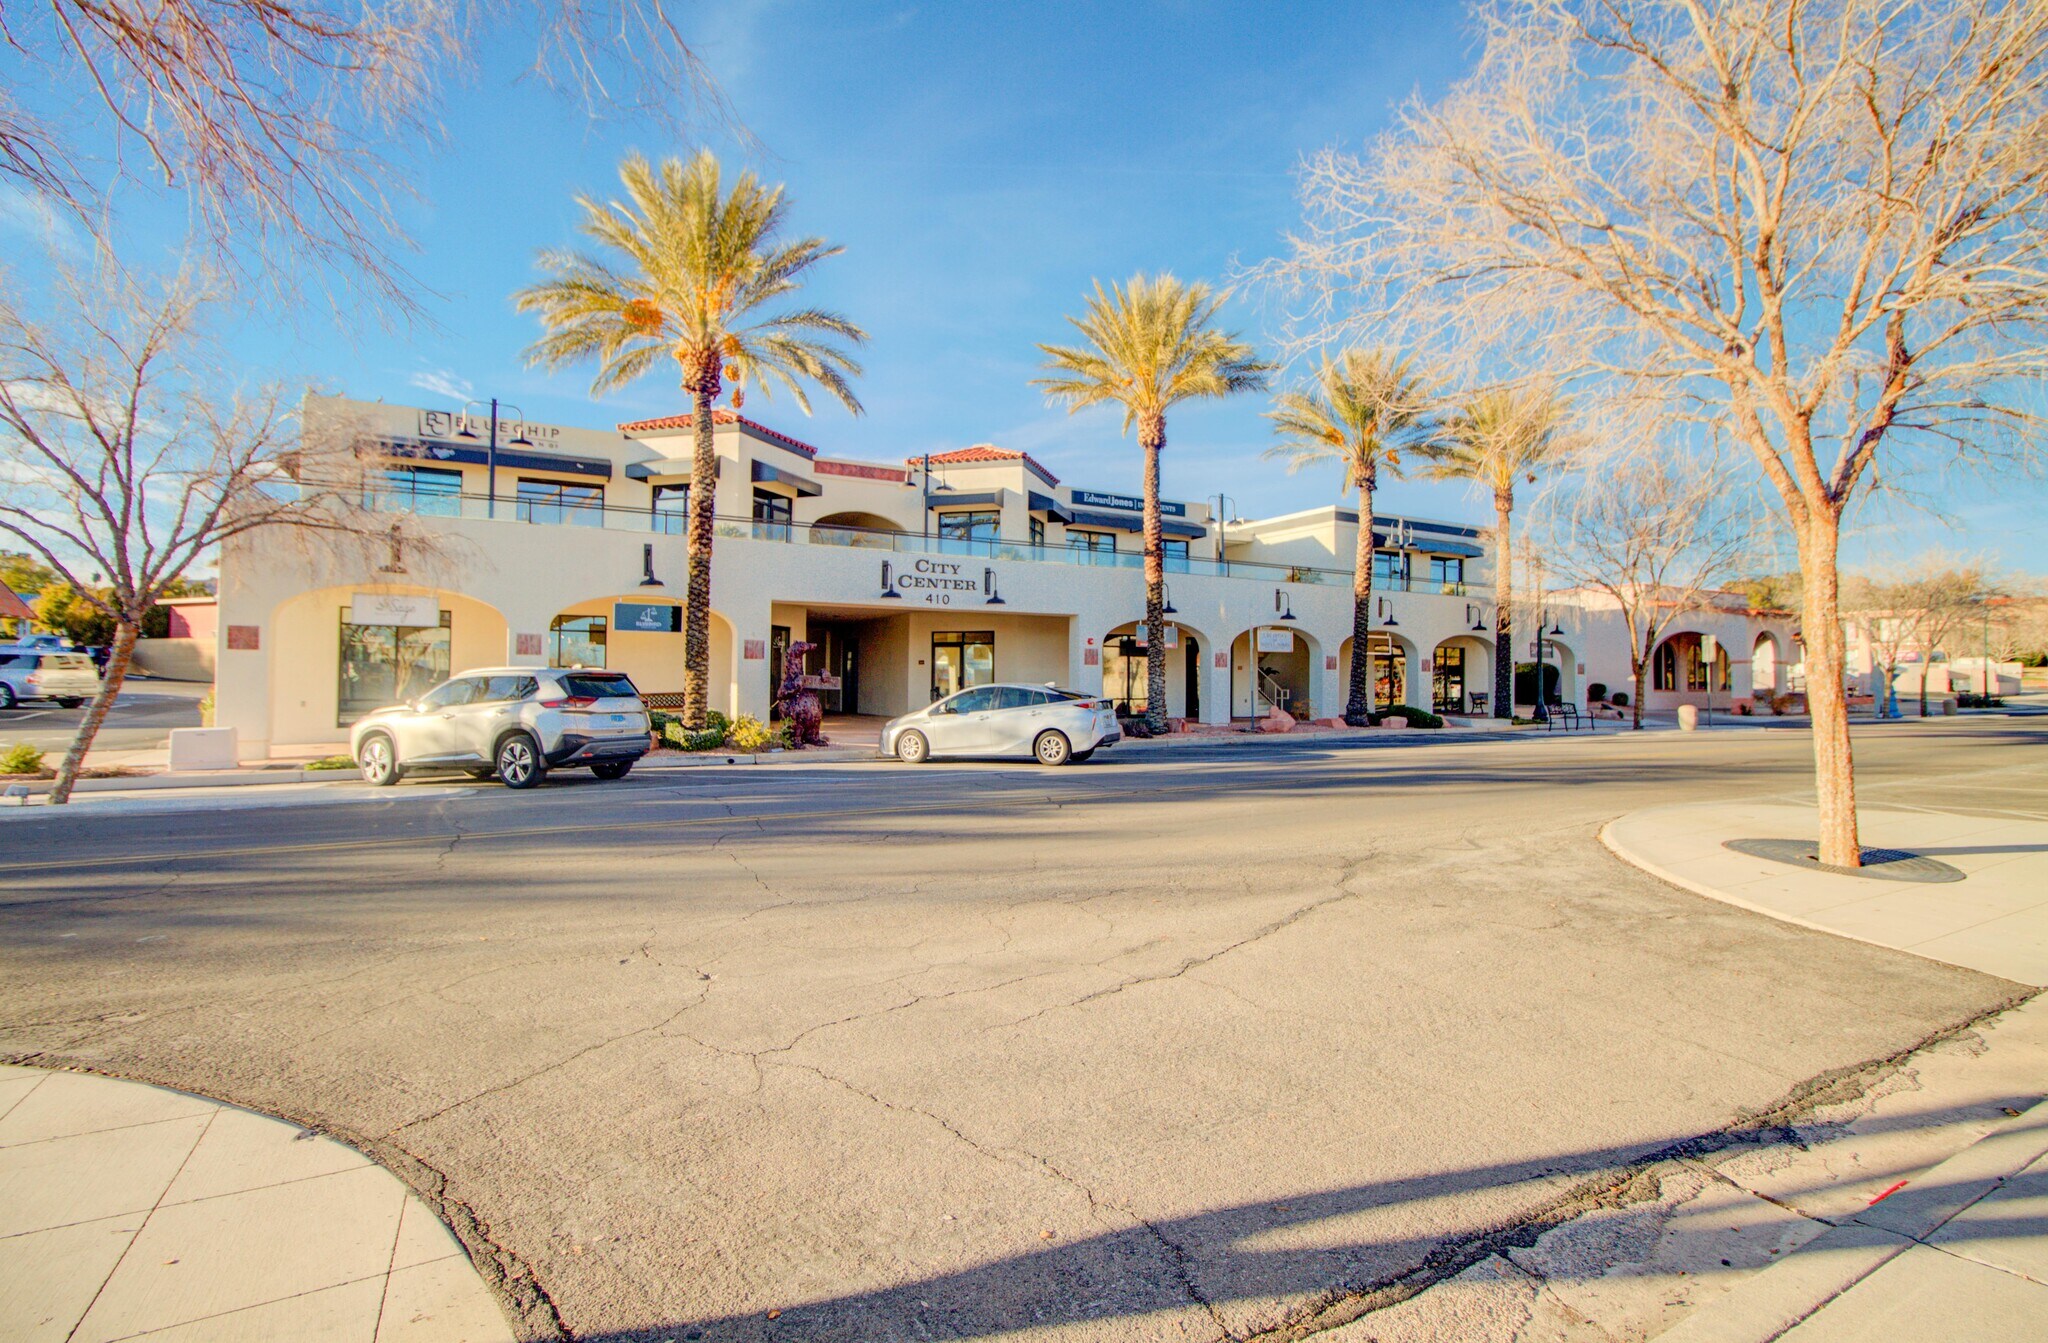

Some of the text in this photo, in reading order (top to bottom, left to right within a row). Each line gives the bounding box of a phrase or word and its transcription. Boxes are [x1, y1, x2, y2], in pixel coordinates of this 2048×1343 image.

[915, 559, 961, 575] CITY
[898, 574, 977, 591] CENTER
[925, 594, 950, 605] 410
